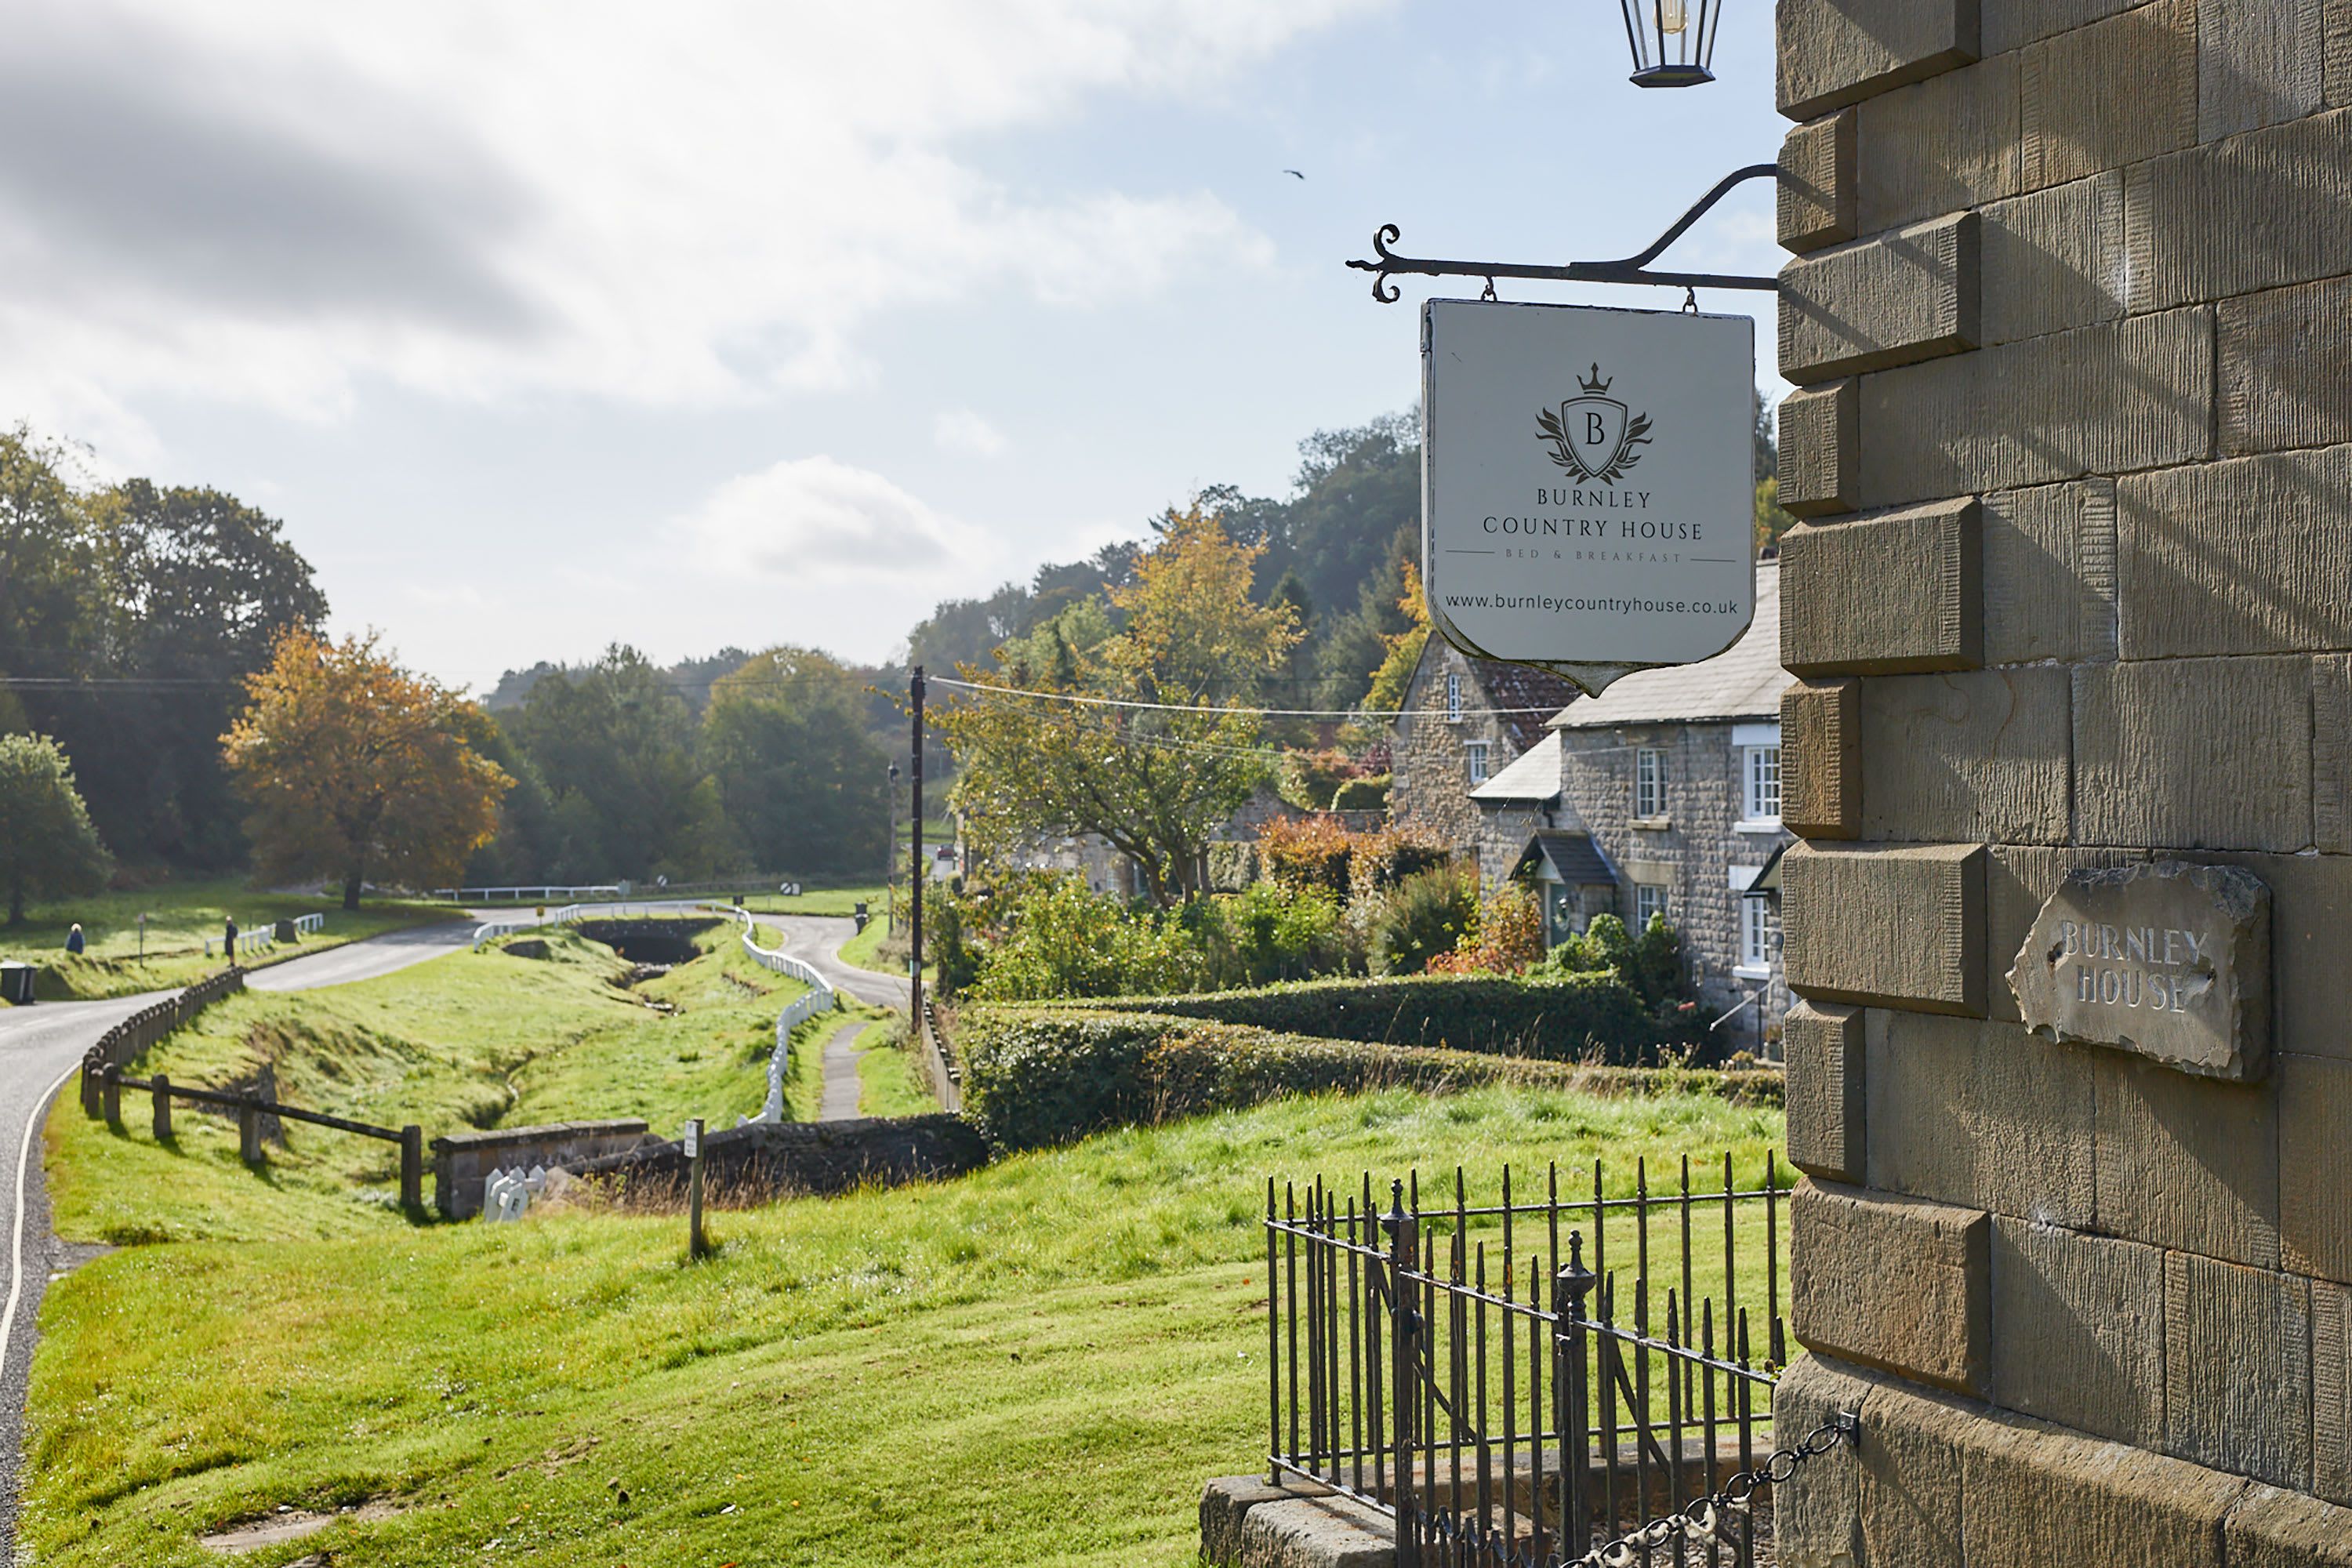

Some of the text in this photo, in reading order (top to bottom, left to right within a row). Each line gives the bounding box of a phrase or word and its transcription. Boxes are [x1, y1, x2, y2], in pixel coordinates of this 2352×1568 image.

[1585, 412, 1606, 445] B
[1537, 488, 1651, 508] BURNLEY
[1483, 517, 1703, 540] COUNTRY HOUSE
[1505, 549, 1682, 564] BED & BREAKFAST
[1446, 593, 1737, 615] www.burnleycountryhouse.co.uk
[2062, 920, 2209, 965] BURNLEY
[2078, 966, 2185, 1013] HOUSE
